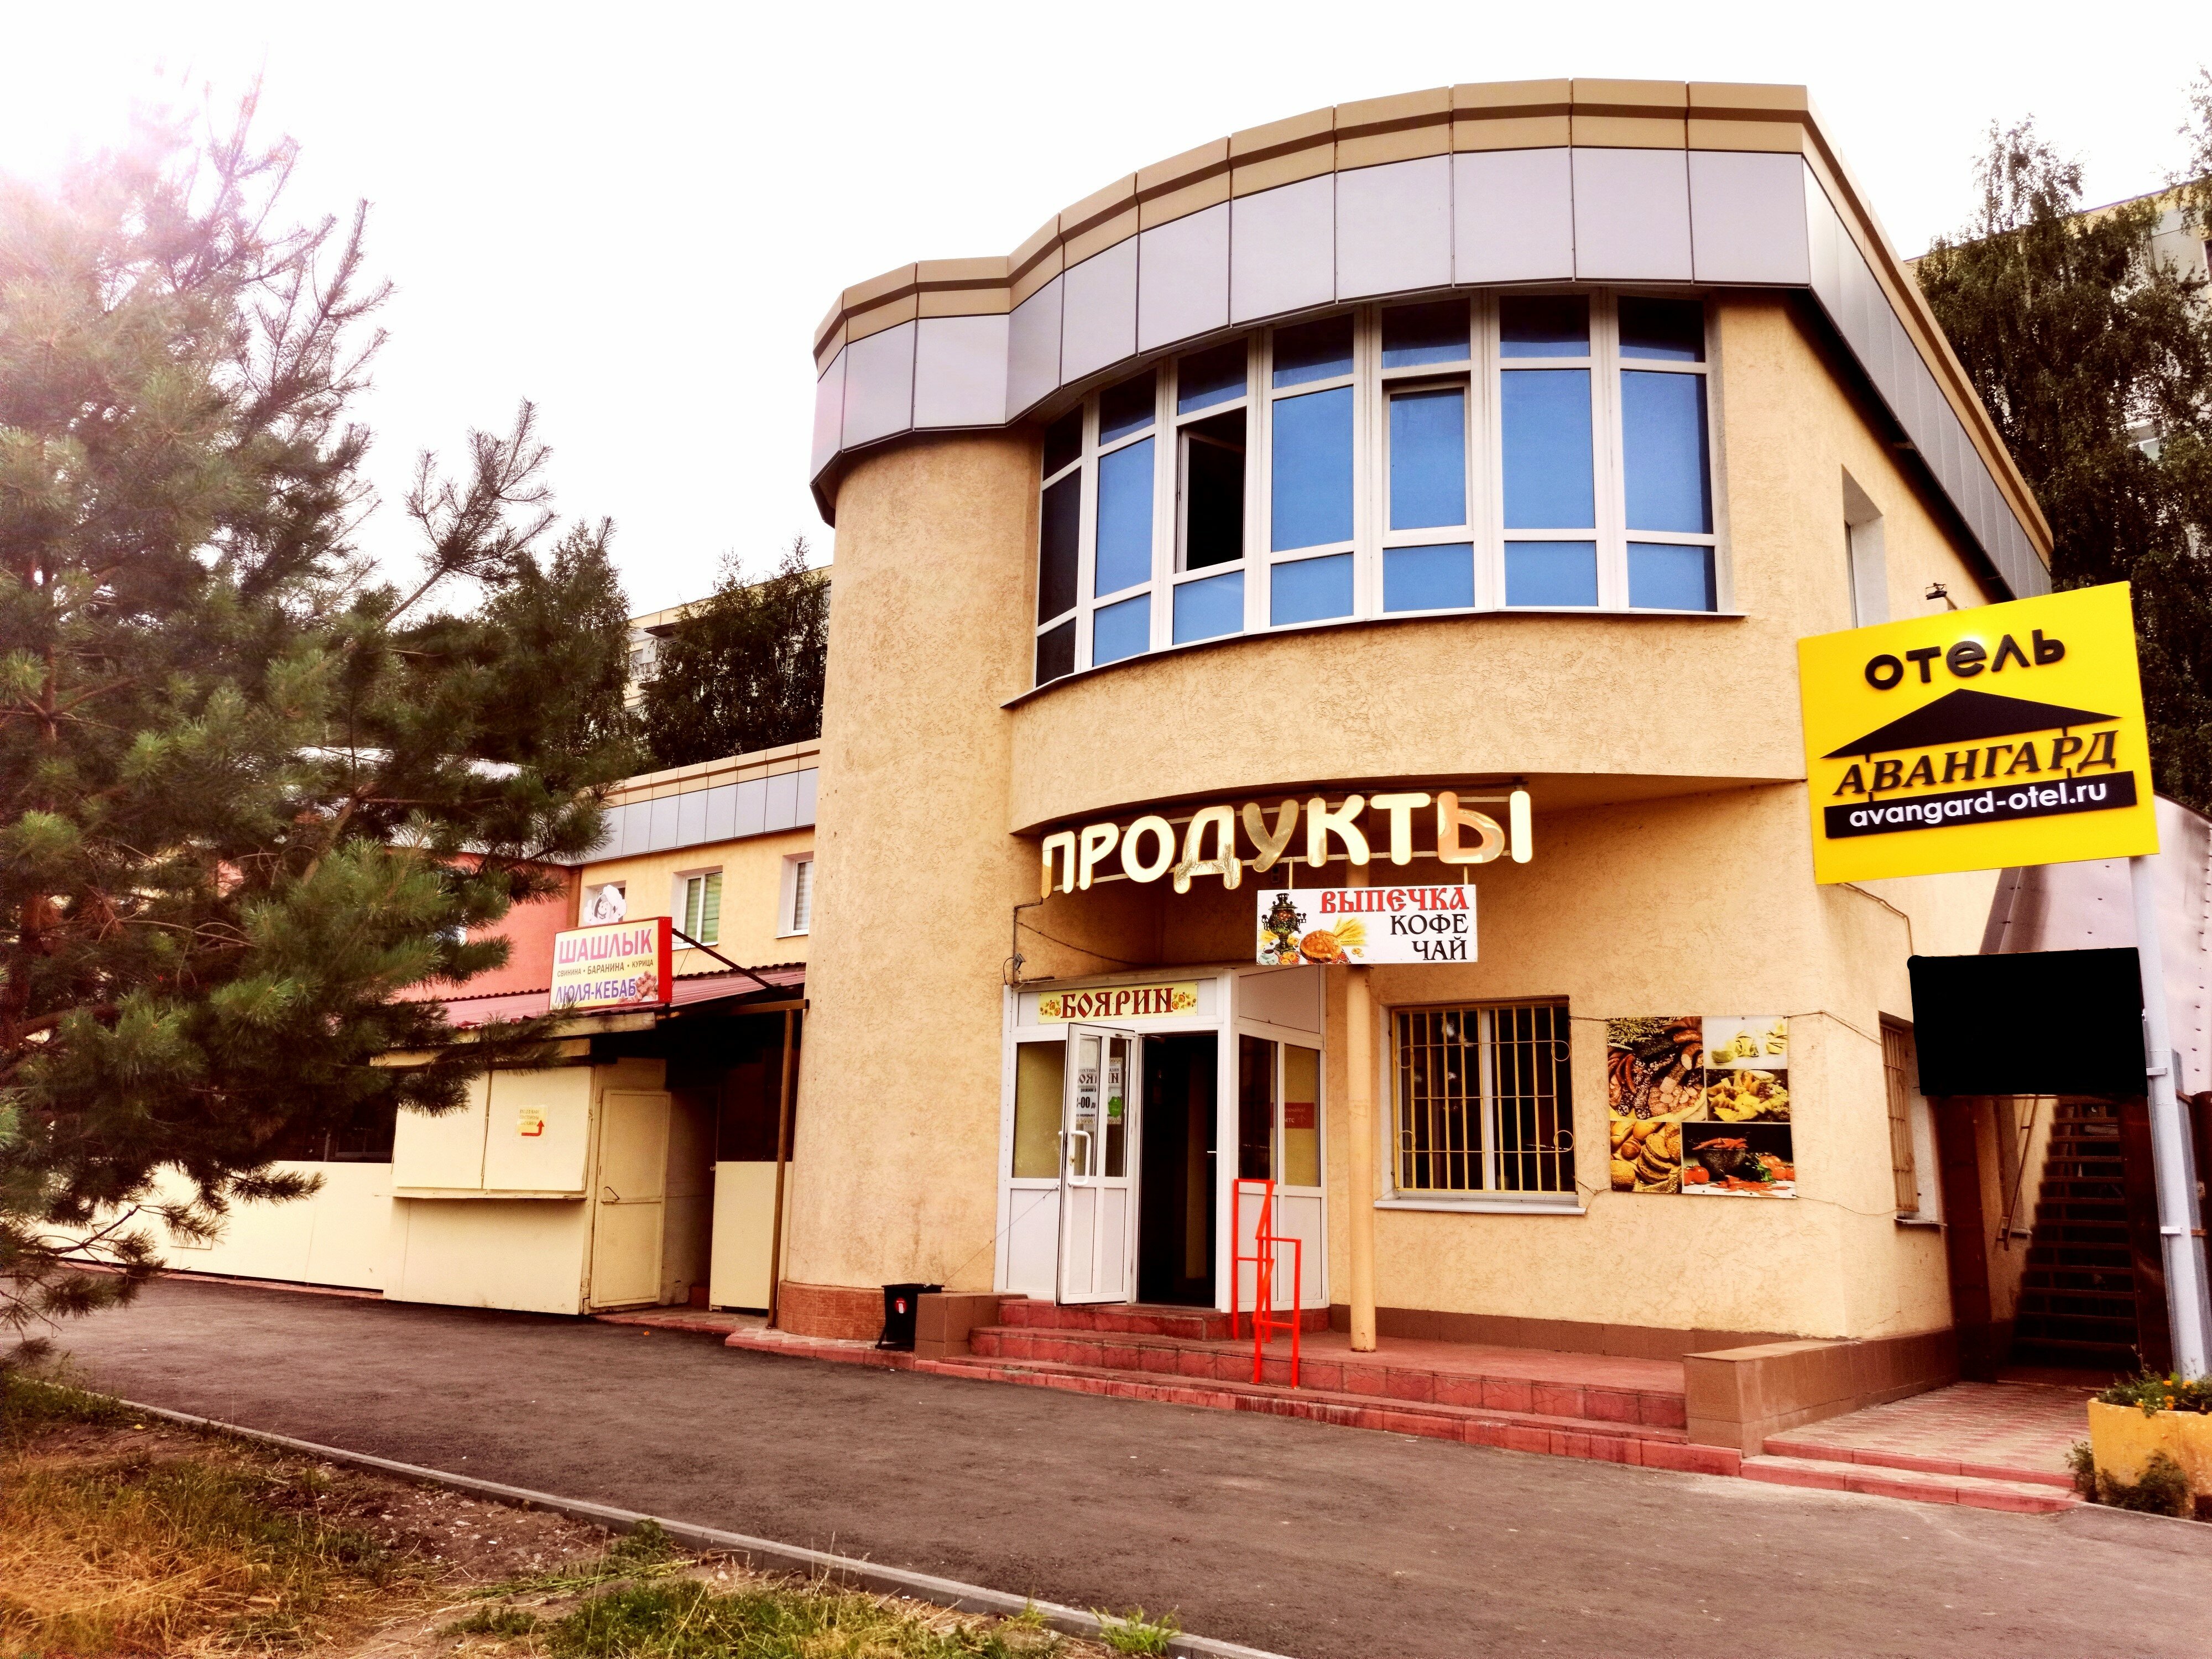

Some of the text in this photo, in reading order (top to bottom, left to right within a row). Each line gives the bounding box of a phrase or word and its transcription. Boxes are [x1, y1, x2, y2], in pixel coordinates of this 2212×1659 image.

[1833, 731, 2119, 795] АВАНГАРД
[1849, 782, 2106, 826] avangard-otel.ru
[1041, 791, 1533, 899] ПРОДУКТЫ
[1320, 887, 1469, 914] ВЫПЕЧКА
[1390, 914, 1469, 936] КОФЕ
[559, 928, 653, 964] ШАШЛЫК
[1411, 935, 1468, 960] ЧАЙ
[557, 959, 654, 978] СВИНИНА БАРАНИНА КУРИЦА
[555, 979, 636, 1004] ЛЮЛЯ-КЕБАБ
[1060, 988, 1174, 1018] БОЯРИН
